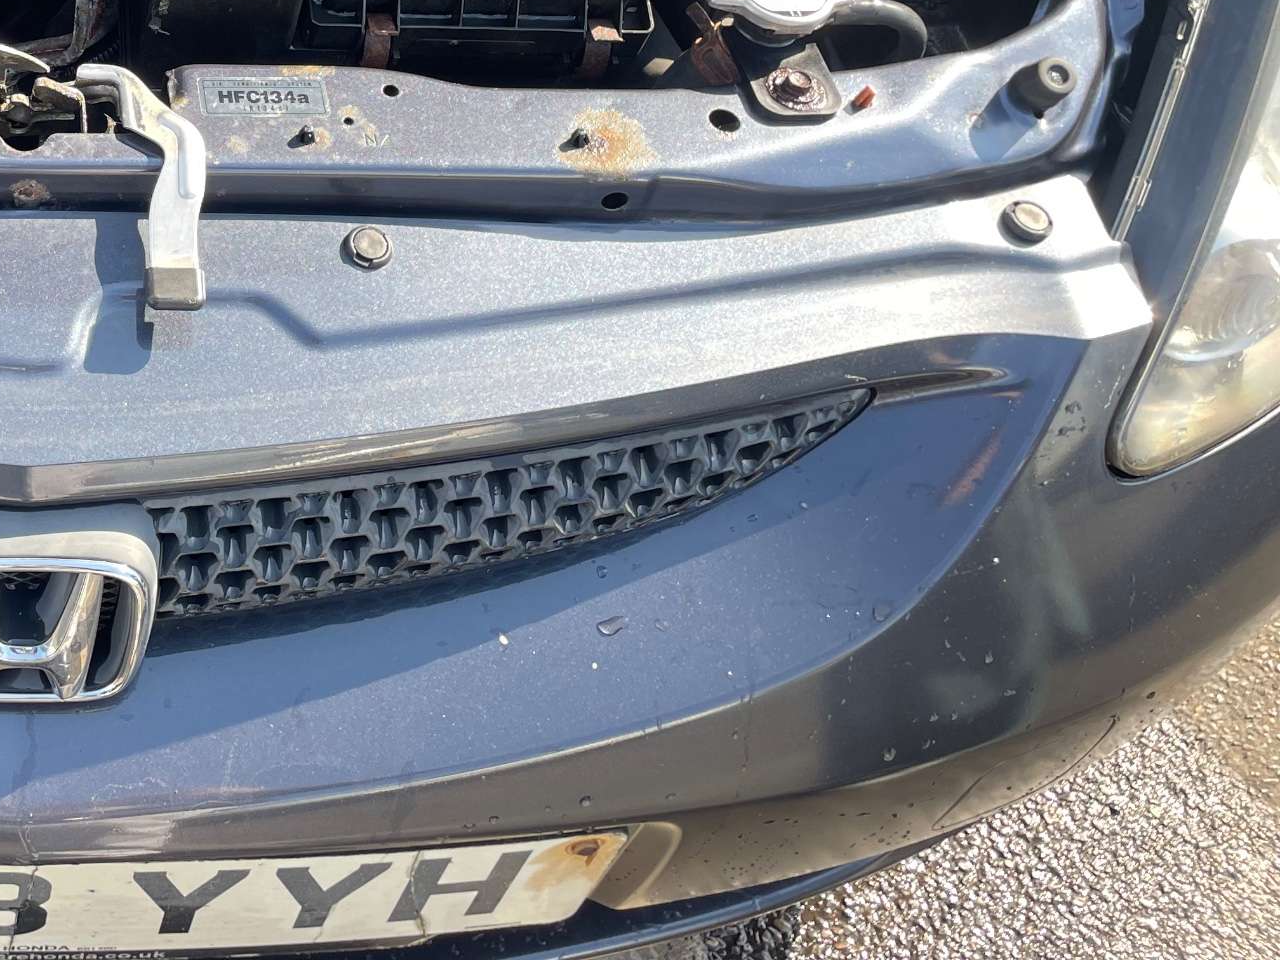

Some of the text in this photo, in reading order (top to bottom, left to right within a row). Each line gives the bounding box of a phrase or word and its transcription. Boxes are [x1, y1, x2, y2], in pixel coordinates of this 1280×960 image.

[218, 90, 311, 104] HFC134a
[133, 850, 534, 934] YYH
[2, 944, 70, 952] HONDA
